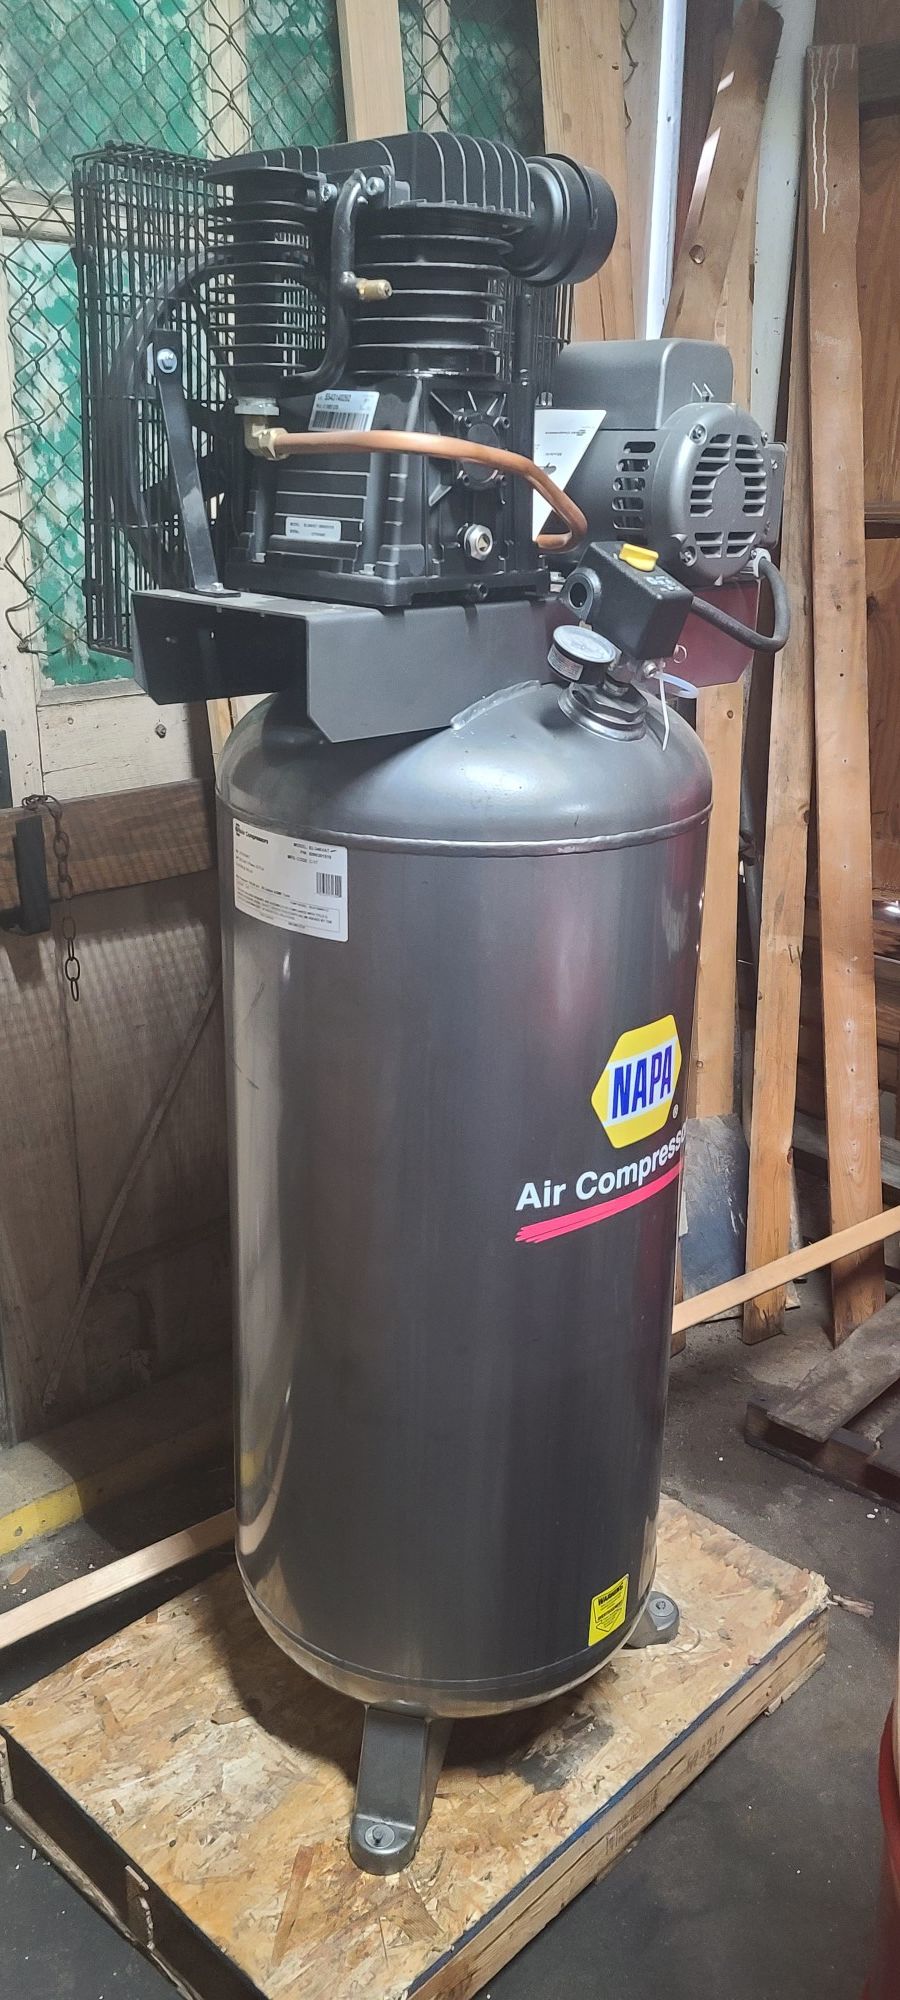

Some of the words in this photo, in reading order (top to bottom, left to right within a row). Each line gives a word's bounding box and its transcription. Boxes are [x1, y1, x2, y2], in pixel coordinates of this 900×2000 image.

[612, 1045, 673, 1119] NAPA
[515, 1179, 566, 1211] Air
[576, 1121, 687, 1200] Compresso
